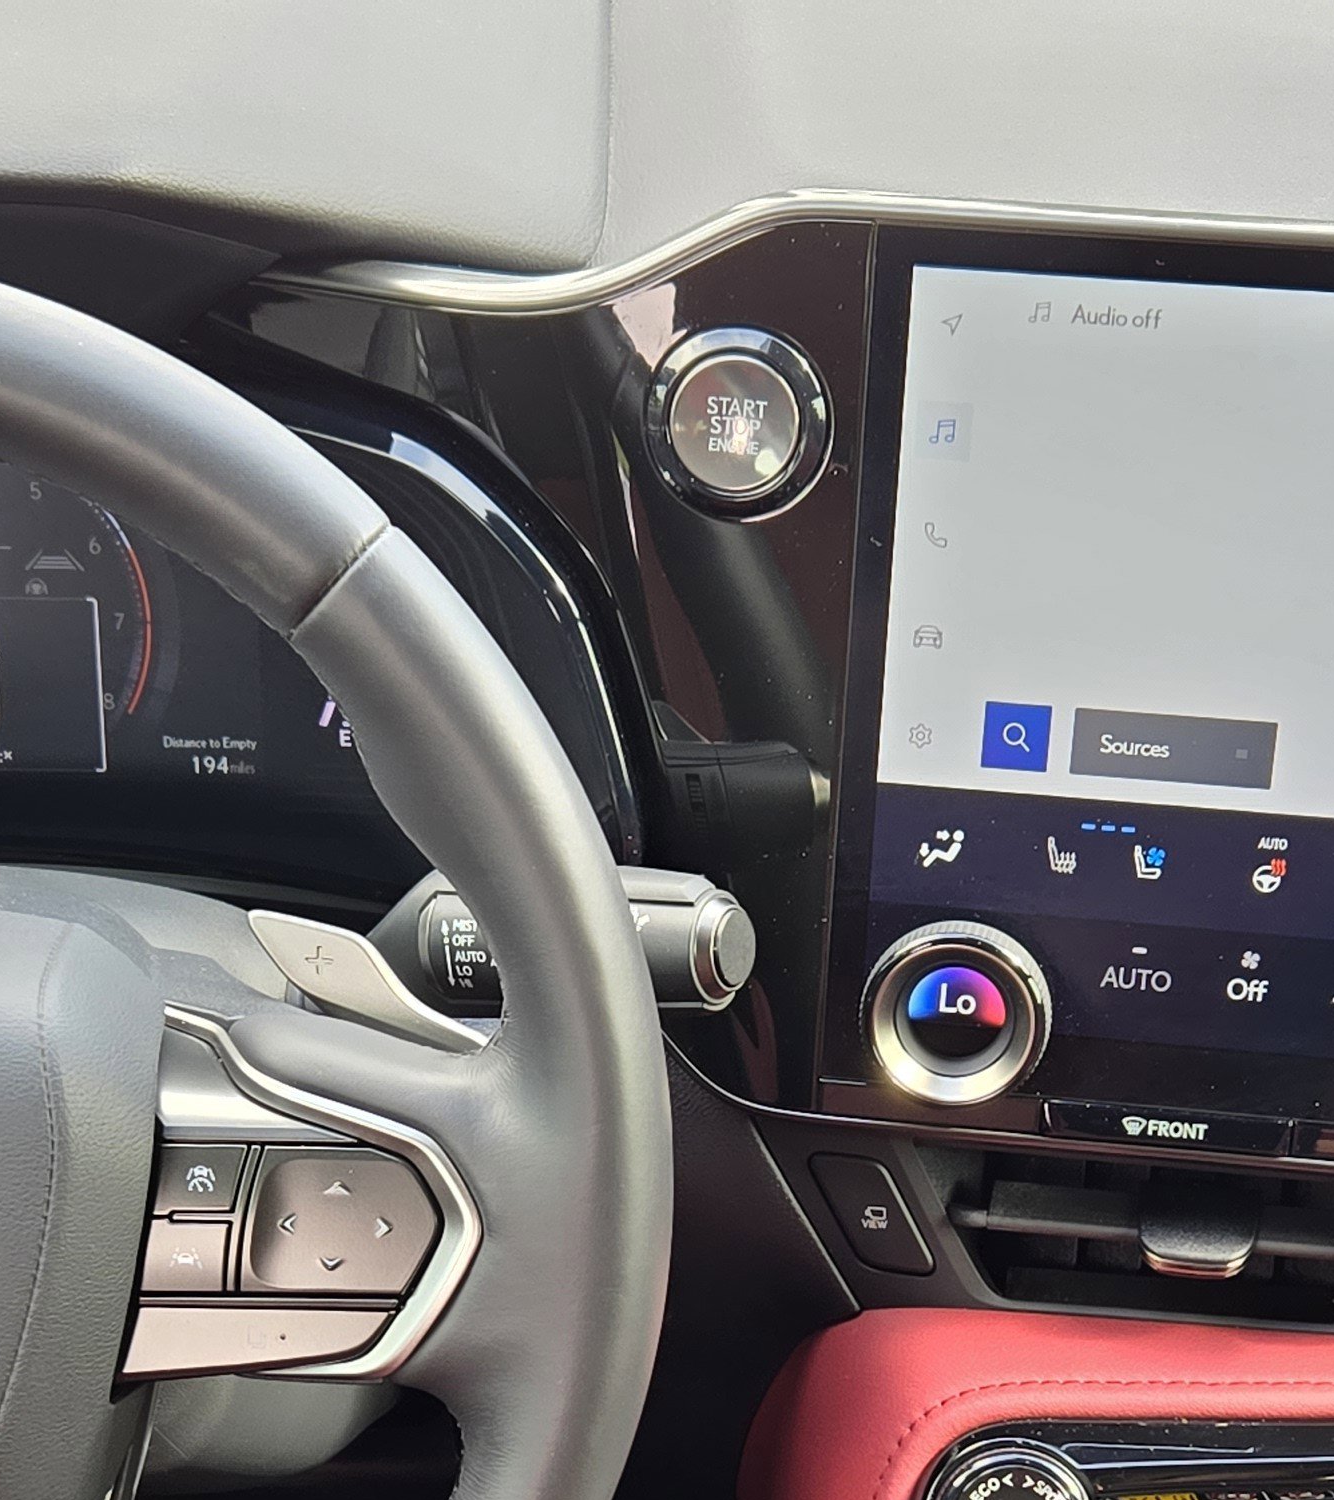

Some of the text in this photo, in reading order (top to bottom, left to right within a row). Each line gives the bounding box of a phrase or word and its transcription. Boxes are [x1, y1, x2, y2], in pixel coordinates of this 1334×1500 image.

[1071, 303, 1163, 329] Audio off
[707, 396, 768, 419] START
[710, 416, 761, 437] STOP
[708, 437, 759, 455] ENGE
[29, 481, 42, 500] 5
[89, 537, 101, 555] 6
[113, 612, 125, 630] 7
[103, 692, 116, 710] 8
[162, 735, 257, 750] Distance to Empty
[339, 728, 352, 747] E
[1100, 734, 1170, 758] Sources
[192, 755, 229, 774] 194
[1257, 837, 1288, 850] AUTO
[452, 919, 477, 932] MIST
[452, 934, 475, 947] OFF
[455, 950, 487, 962] AUTO
[455, 965, 473, 976] LO
[1100, 965, 1172, 993] AUTO
[1226, 977, 1269, 1003] Off
[938, 983, 977, 1016] Lo
[1147, 1119, 1208, 1141] FRONT
[861, 1218, 888, 1229] VIEW
